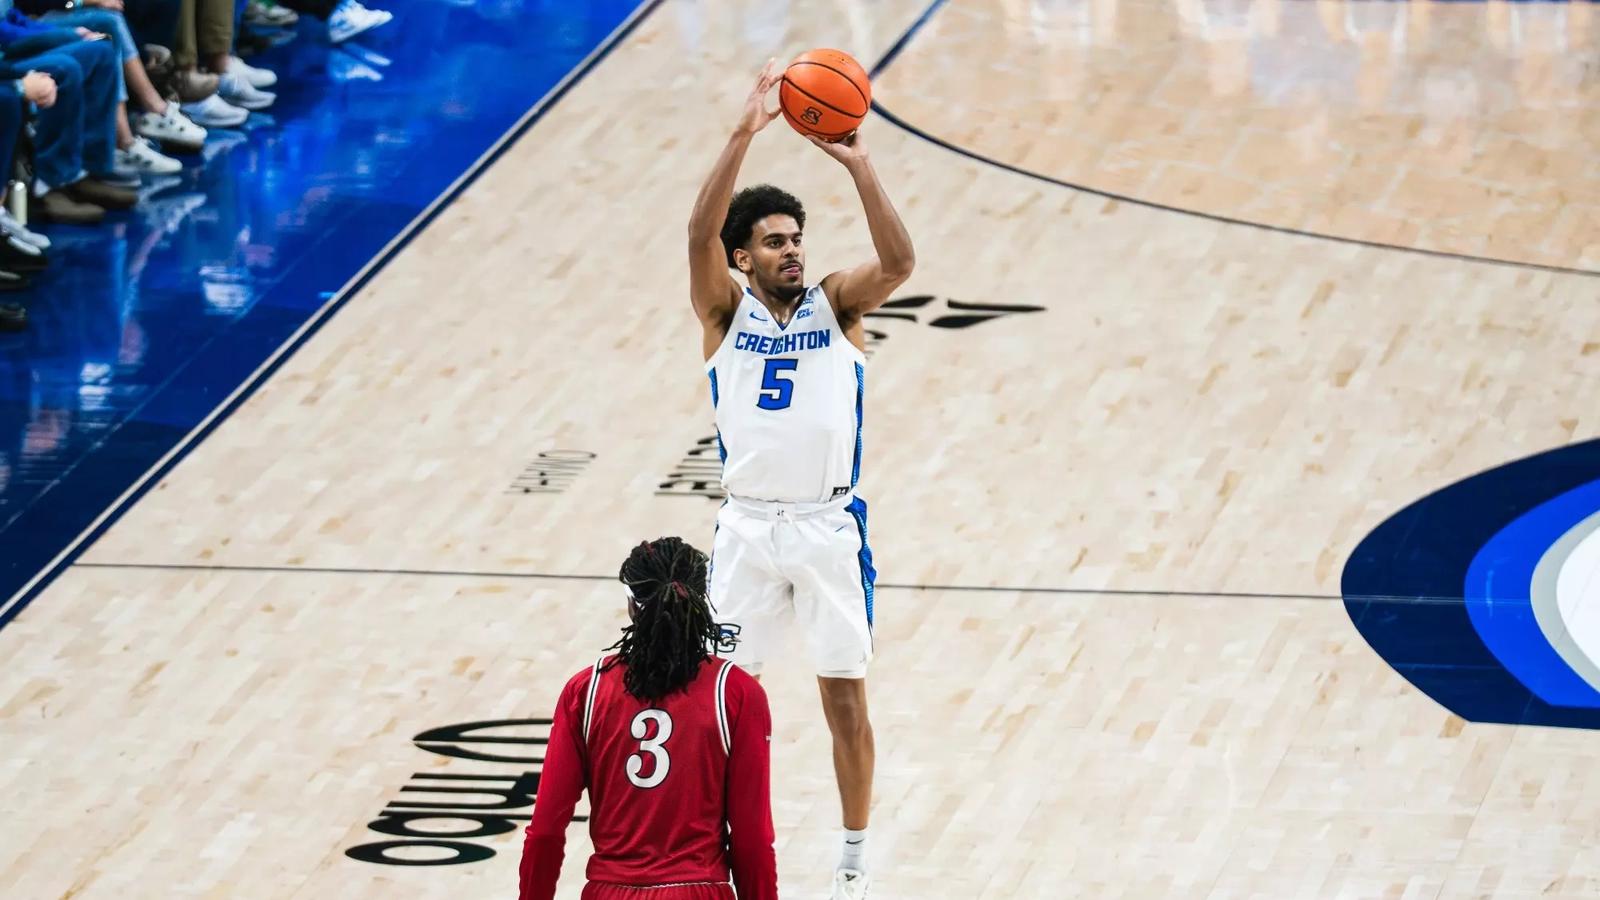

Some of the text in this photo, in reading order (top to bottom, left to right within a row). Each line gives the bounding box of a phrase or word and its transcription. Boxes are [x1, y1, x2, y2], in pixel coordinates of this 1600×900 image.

[734, 329, 830, 355] CREIGHTON
[756, 358, 799, 411] 5
[625, 708, 673, 789] 3
